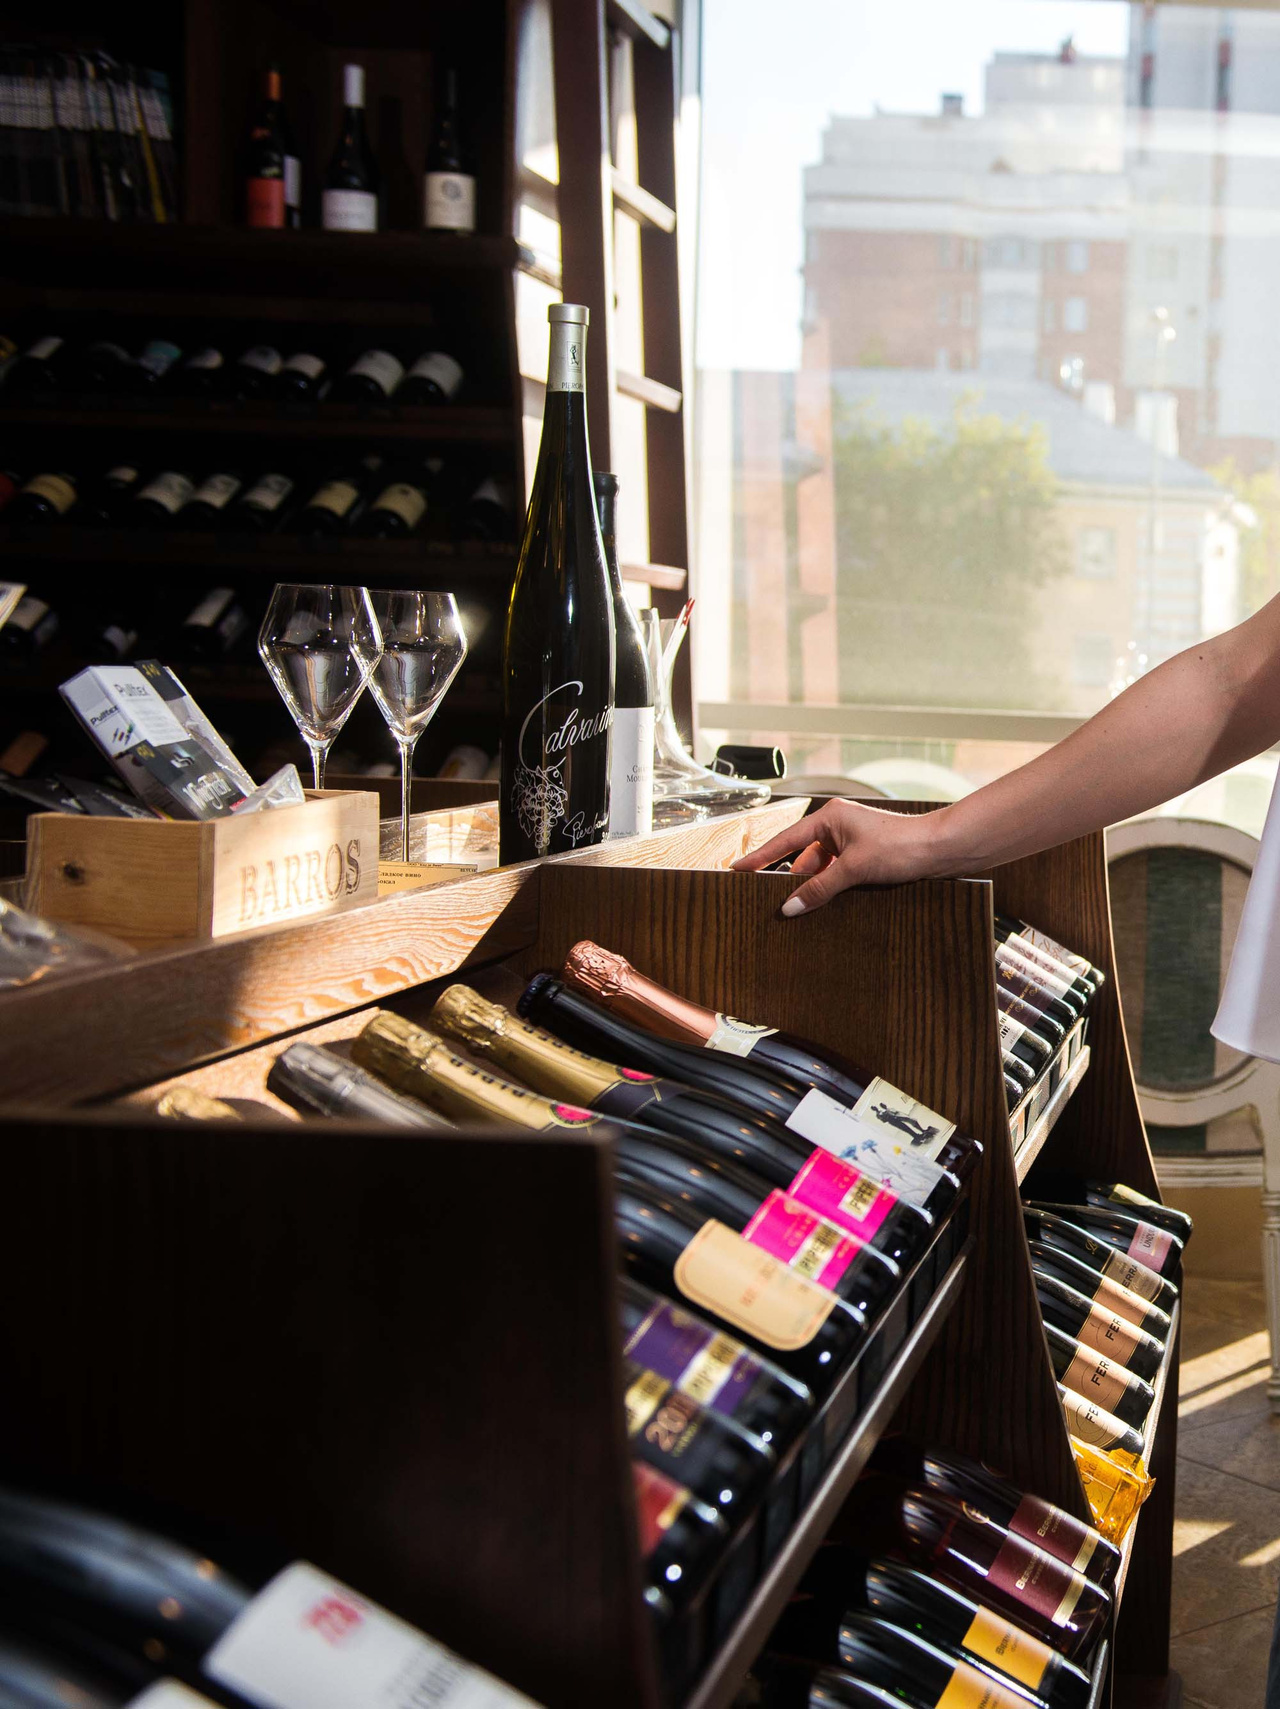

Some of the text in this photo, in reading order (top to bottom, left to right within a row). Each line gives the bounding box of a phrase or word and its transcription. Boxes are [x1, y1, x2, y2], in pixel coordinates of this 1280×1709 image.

[239, 839, 361, 922] BARROS
[1121, 1264, 1138, 1288] ERRA
[1105, 1318, 1121, 1341] FER
[1091, 1360, 1109, 1386] FER
